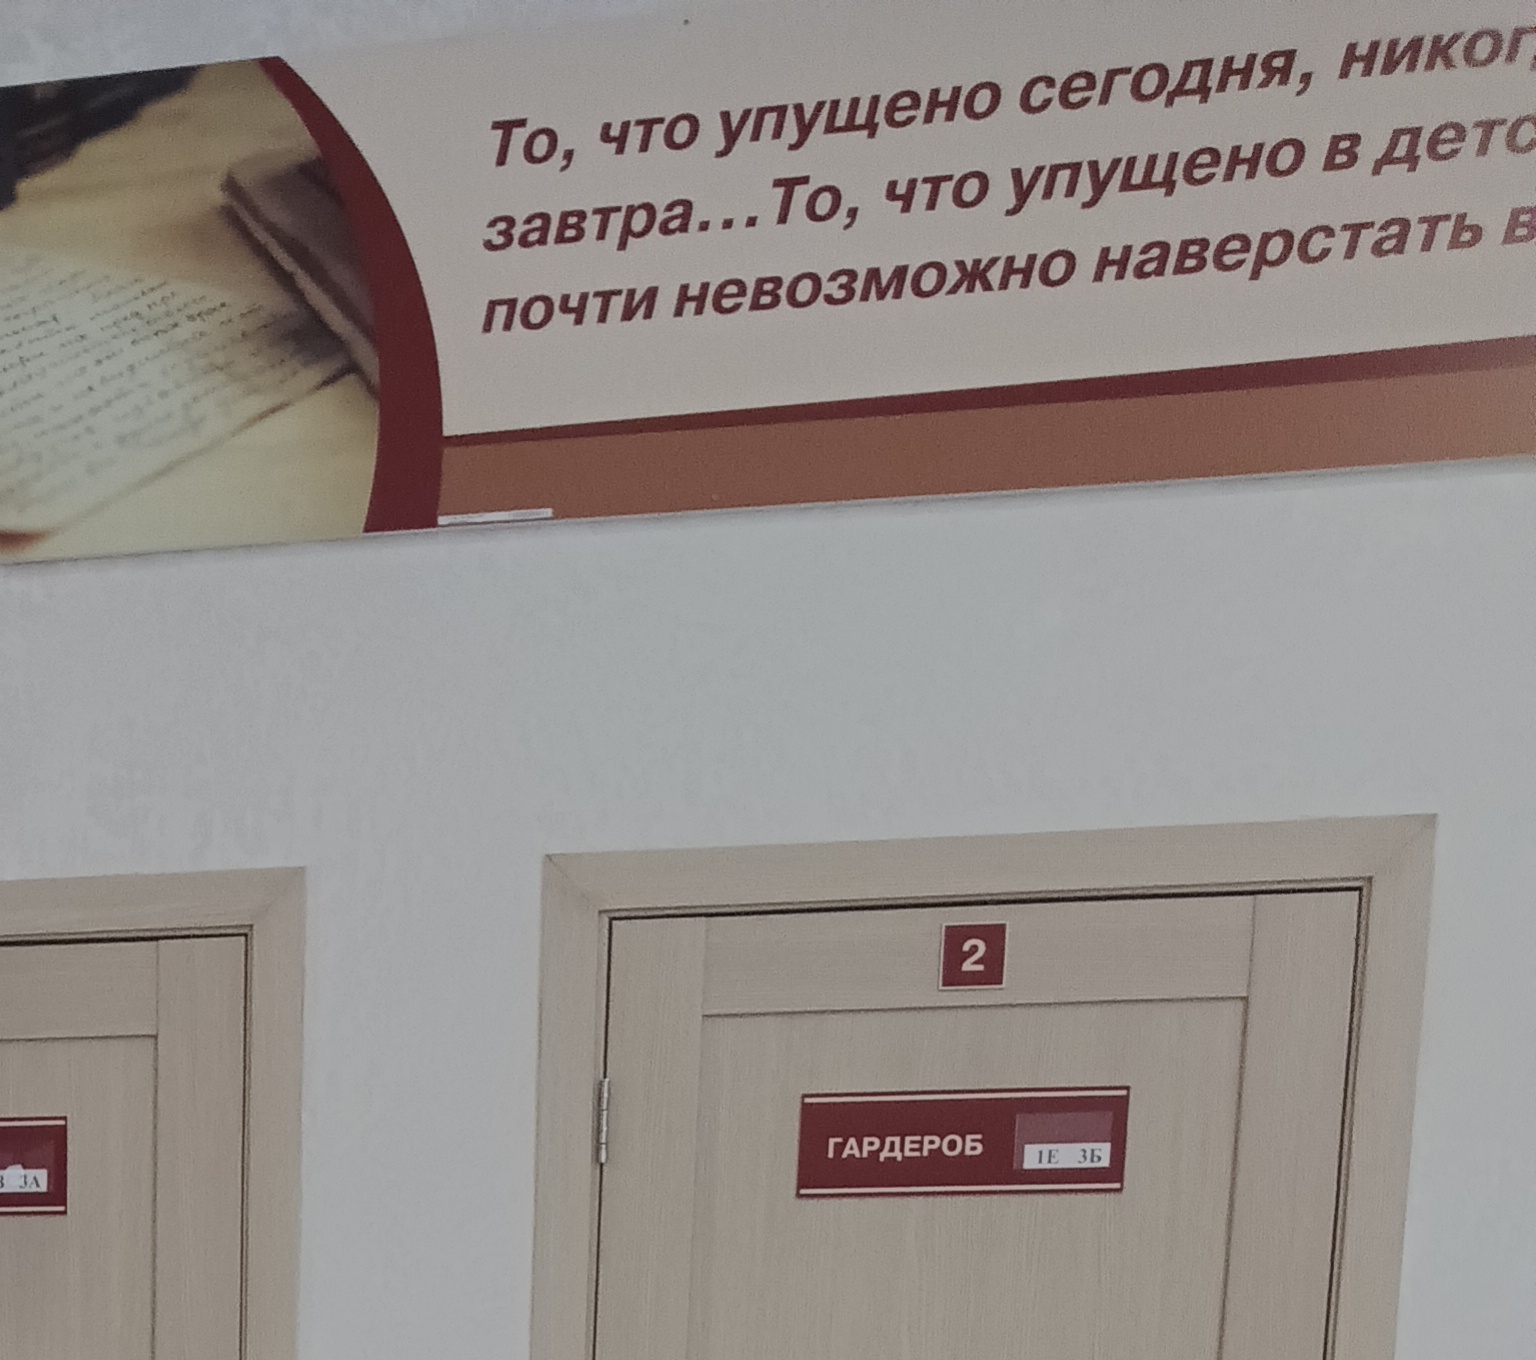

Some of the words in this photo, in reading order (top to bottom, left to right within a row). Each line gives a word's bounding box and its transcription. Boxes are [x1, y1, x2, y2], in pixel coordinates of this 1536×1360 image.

[491, 118, 575, 172] То,
[600, 113, 700, 155] что
[715, 90, 1002, 158] упущено
[1019, 49, 1313, 115] сегодня,
[1338, 24, 1536, 79] никог
[885, 170, 990, 214] что
[1005, 138, 1306, 216] упущено
[1322, 133, 1362, 172] в
[482, 286, 659, 334] почти
[673, 249, 1077, 318] невозможно
[1092, 212, 1483, 283] наверстать
[961, 938, 987, 971] 2
[827, 1133, 983, 1161] ГАРДЕРОБ
[1037, 1150, 1060, 1165] 1Е
[1078, 1147, 1103, 1164] 3Б
[19, 1174, 41, 1189] 3А
